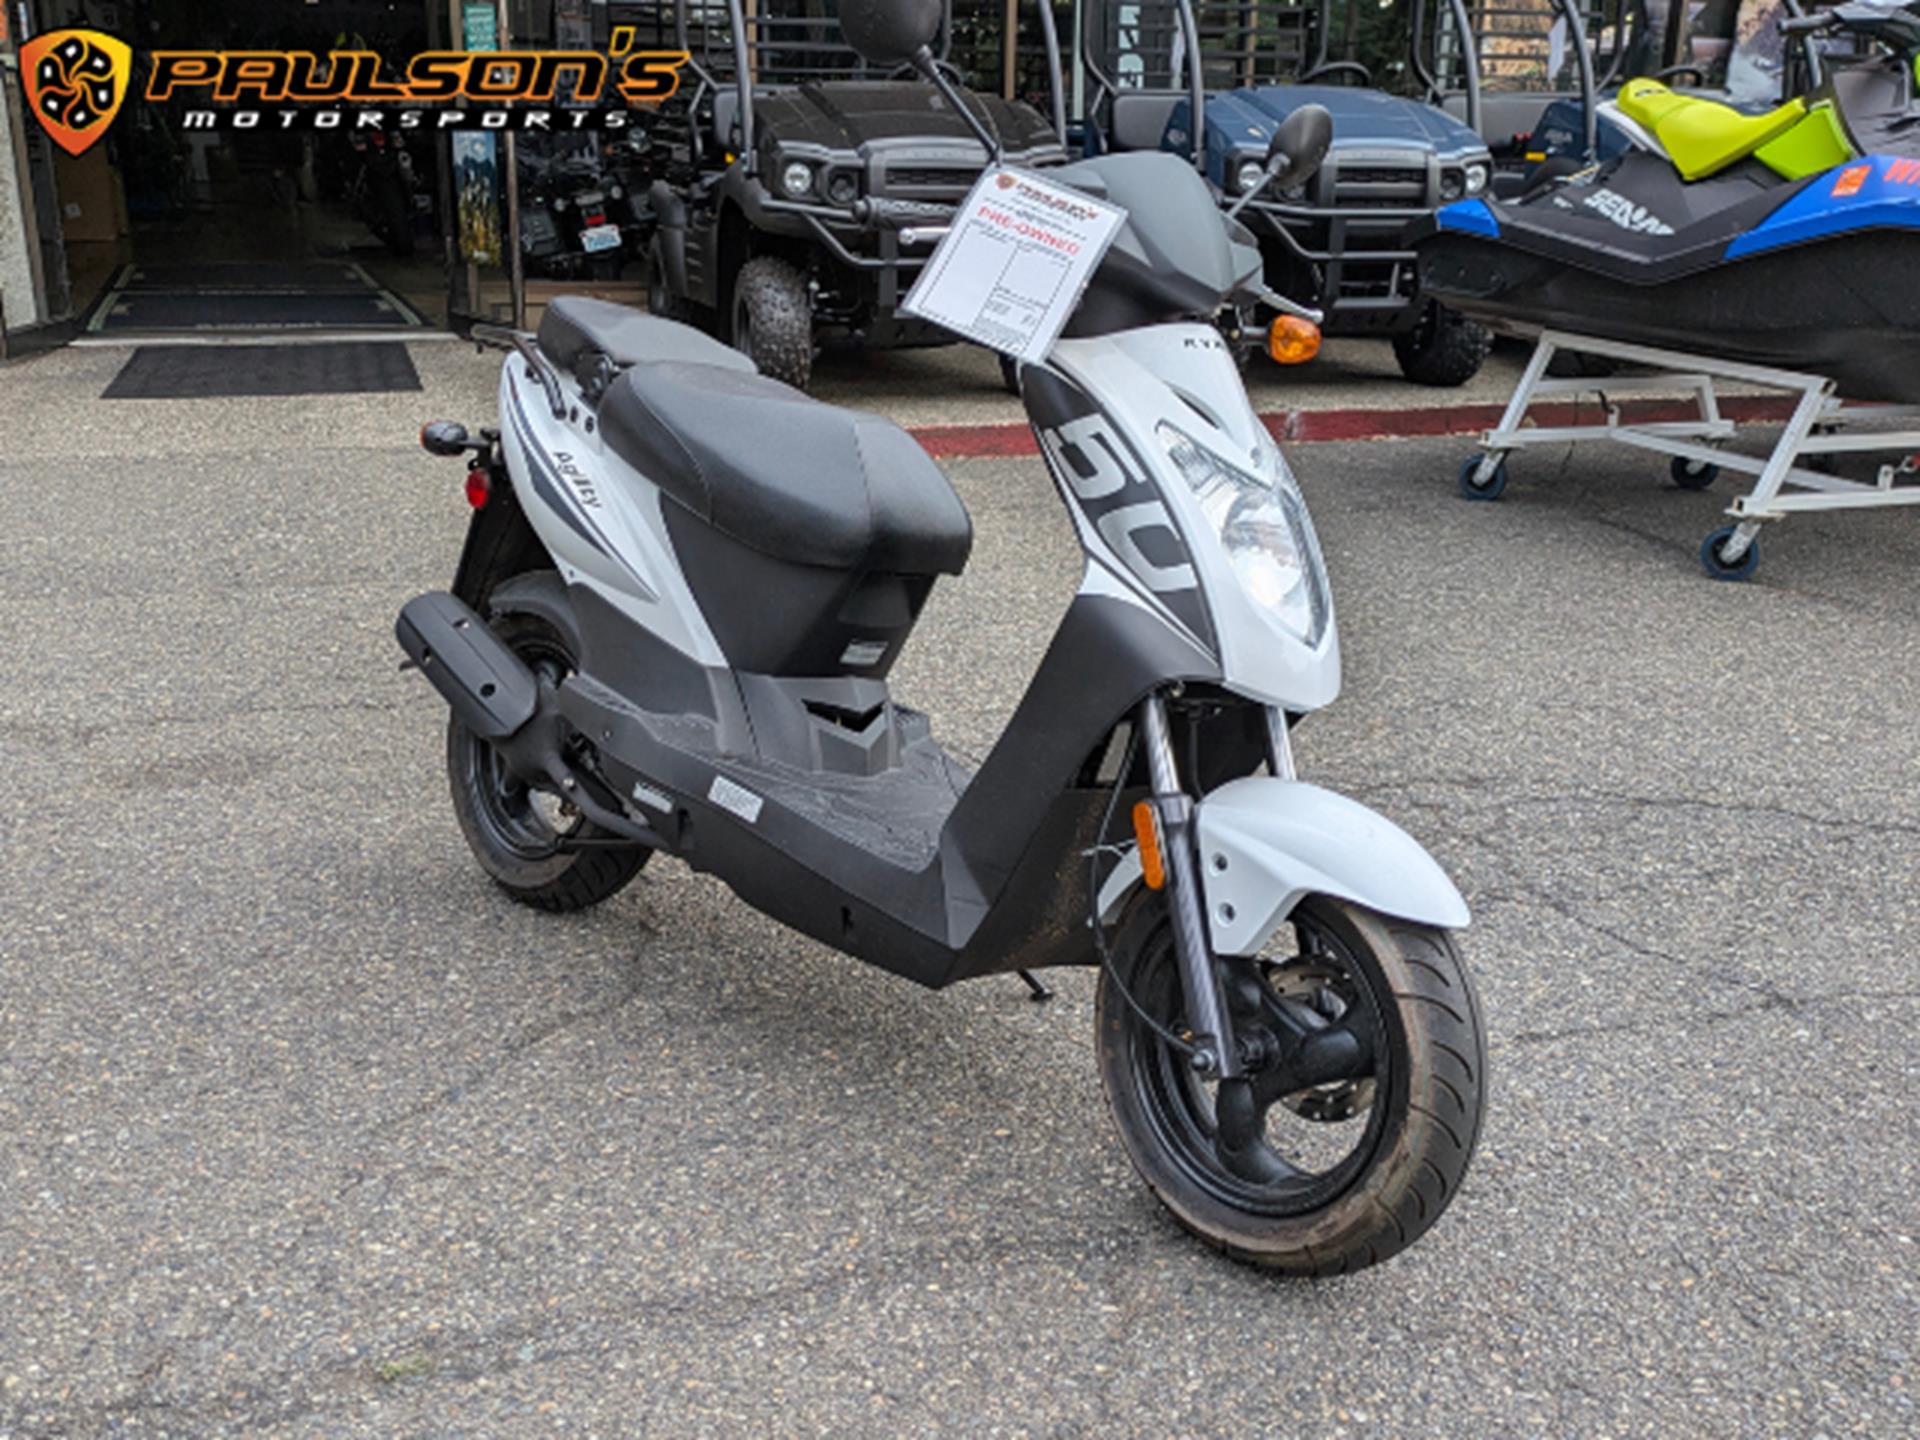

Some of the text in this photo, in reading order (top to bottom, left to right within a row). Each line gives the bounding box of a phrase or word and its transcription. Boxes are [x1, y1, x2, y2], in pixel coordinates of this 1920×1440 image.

[977, 205, 1082, 256] PRE-OWNED
[553, 451, 602, 508] Agility
[1044, 412, 1199, 592] 50
